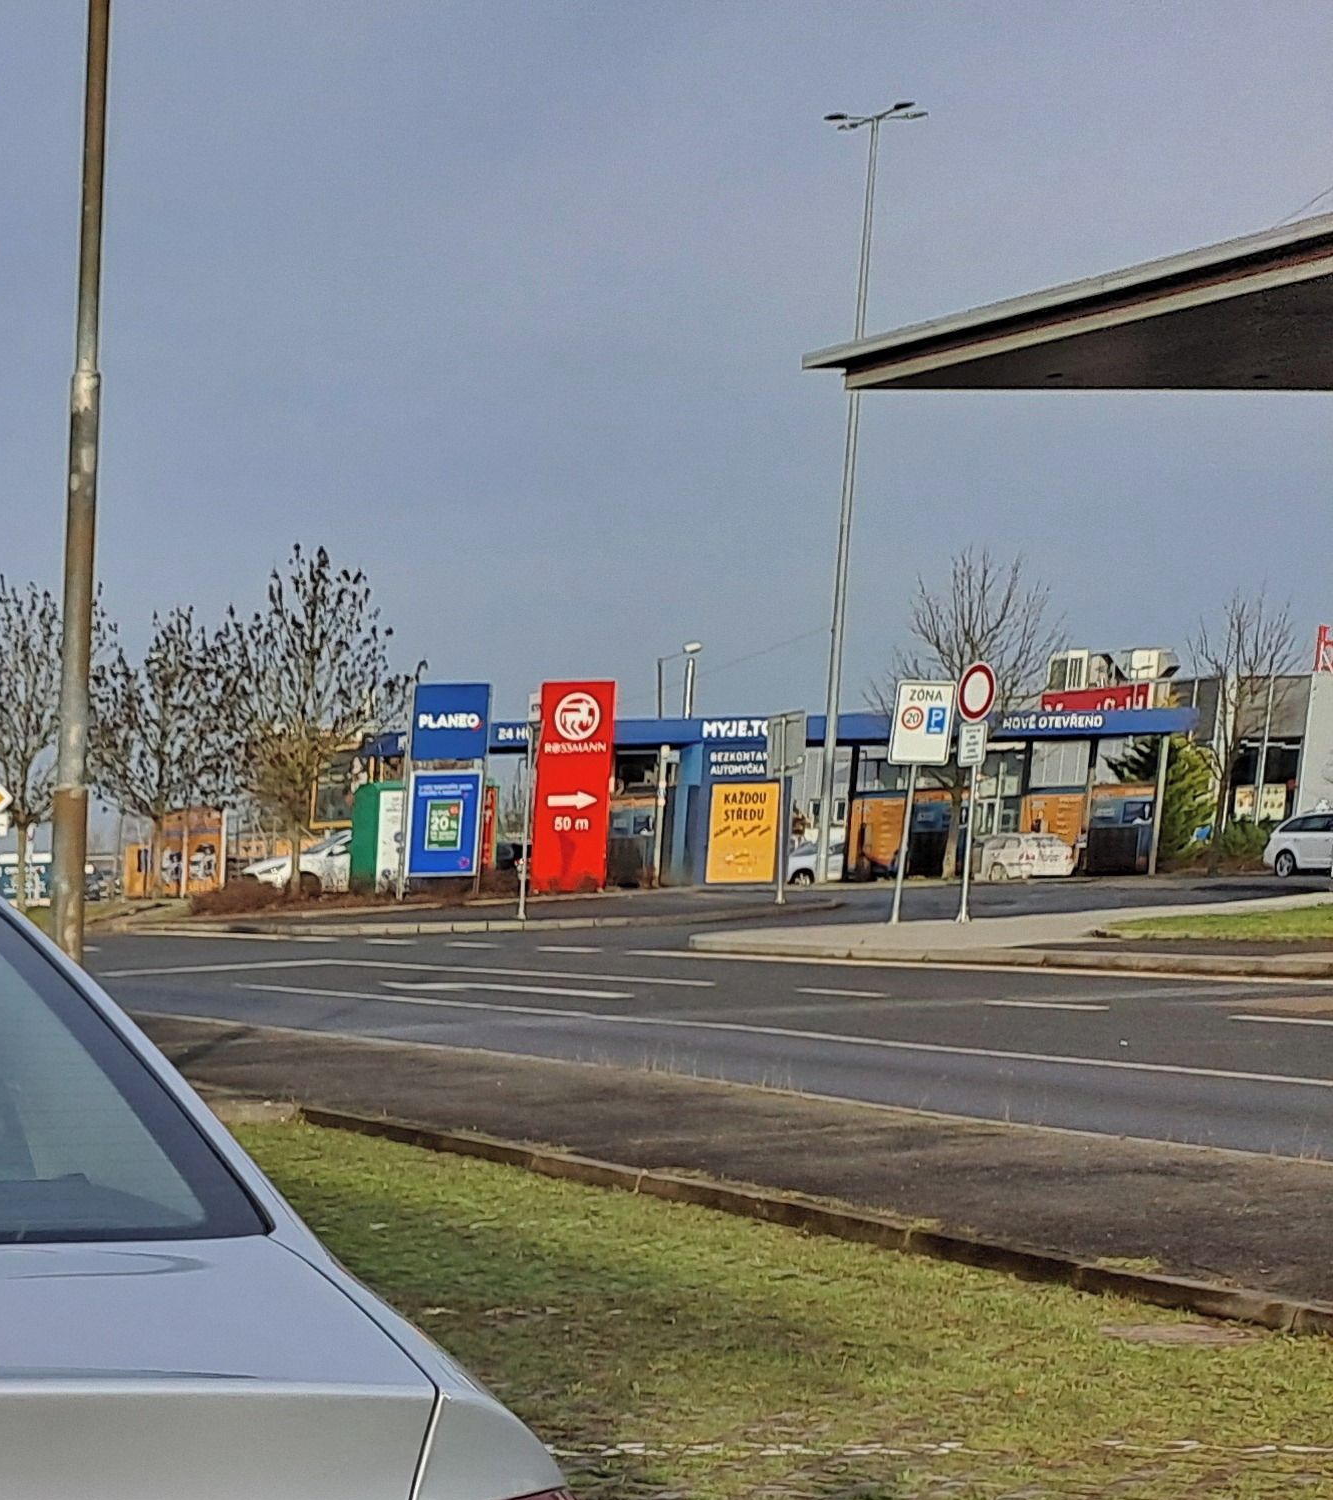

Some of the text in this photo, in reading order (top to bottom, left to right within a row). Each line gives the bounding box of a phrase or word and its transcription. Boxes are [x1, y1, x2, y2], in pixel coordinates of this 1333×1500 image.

[909, 688, 943, 702] ZÓNA
[418, 713, 480, 729] PLANEO
[905, 712, 920, 725] 20
[931, 709, 944, 727] P
[1038, 713, 1103, 729] OTEVŘENO
[498, 727, 515, 741] 24
[544, 742, 607, 754] ROSSMANN
[710, 763, 766, 776] AUTOMYČKA
[723, 790, 767, 805] KAŽDOU
[723, 807, 765, 822] STŘEDU
[430, 815, 449, 831] 20
[554, 816, 589, 831] 50 m
